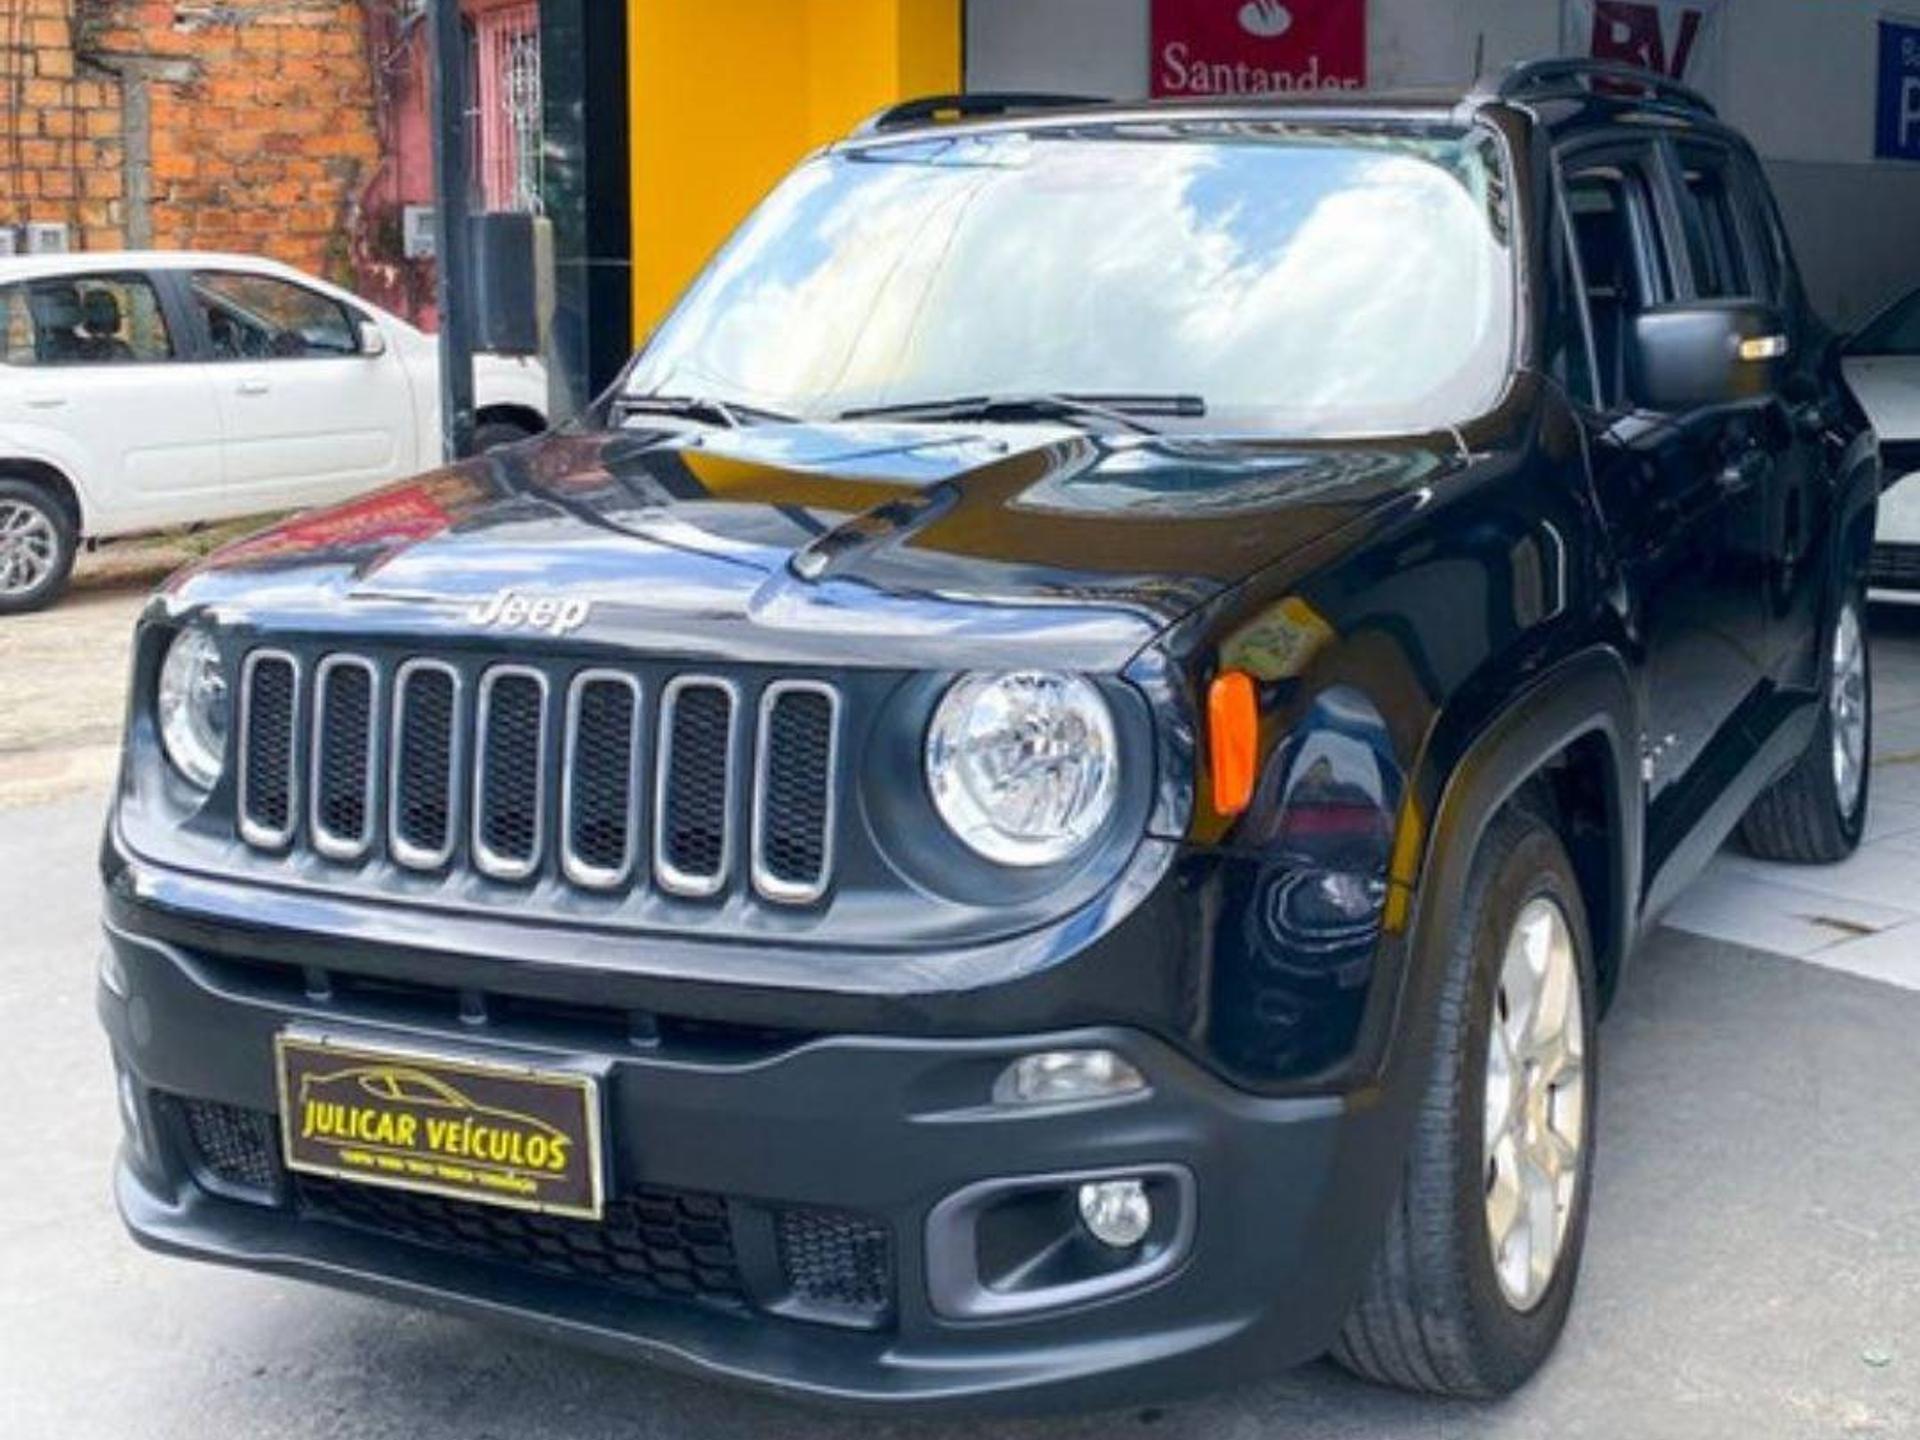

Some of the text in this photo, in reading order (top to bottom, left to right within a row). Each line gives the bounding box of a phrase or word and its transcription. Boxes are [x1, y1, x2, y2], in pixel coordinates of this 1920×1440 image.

[467, 588, 591, 637] Jeep
[302, 1099, 417, 1147] JULICAR
[427, 1115, 567, 1171] VEÍCULOS
